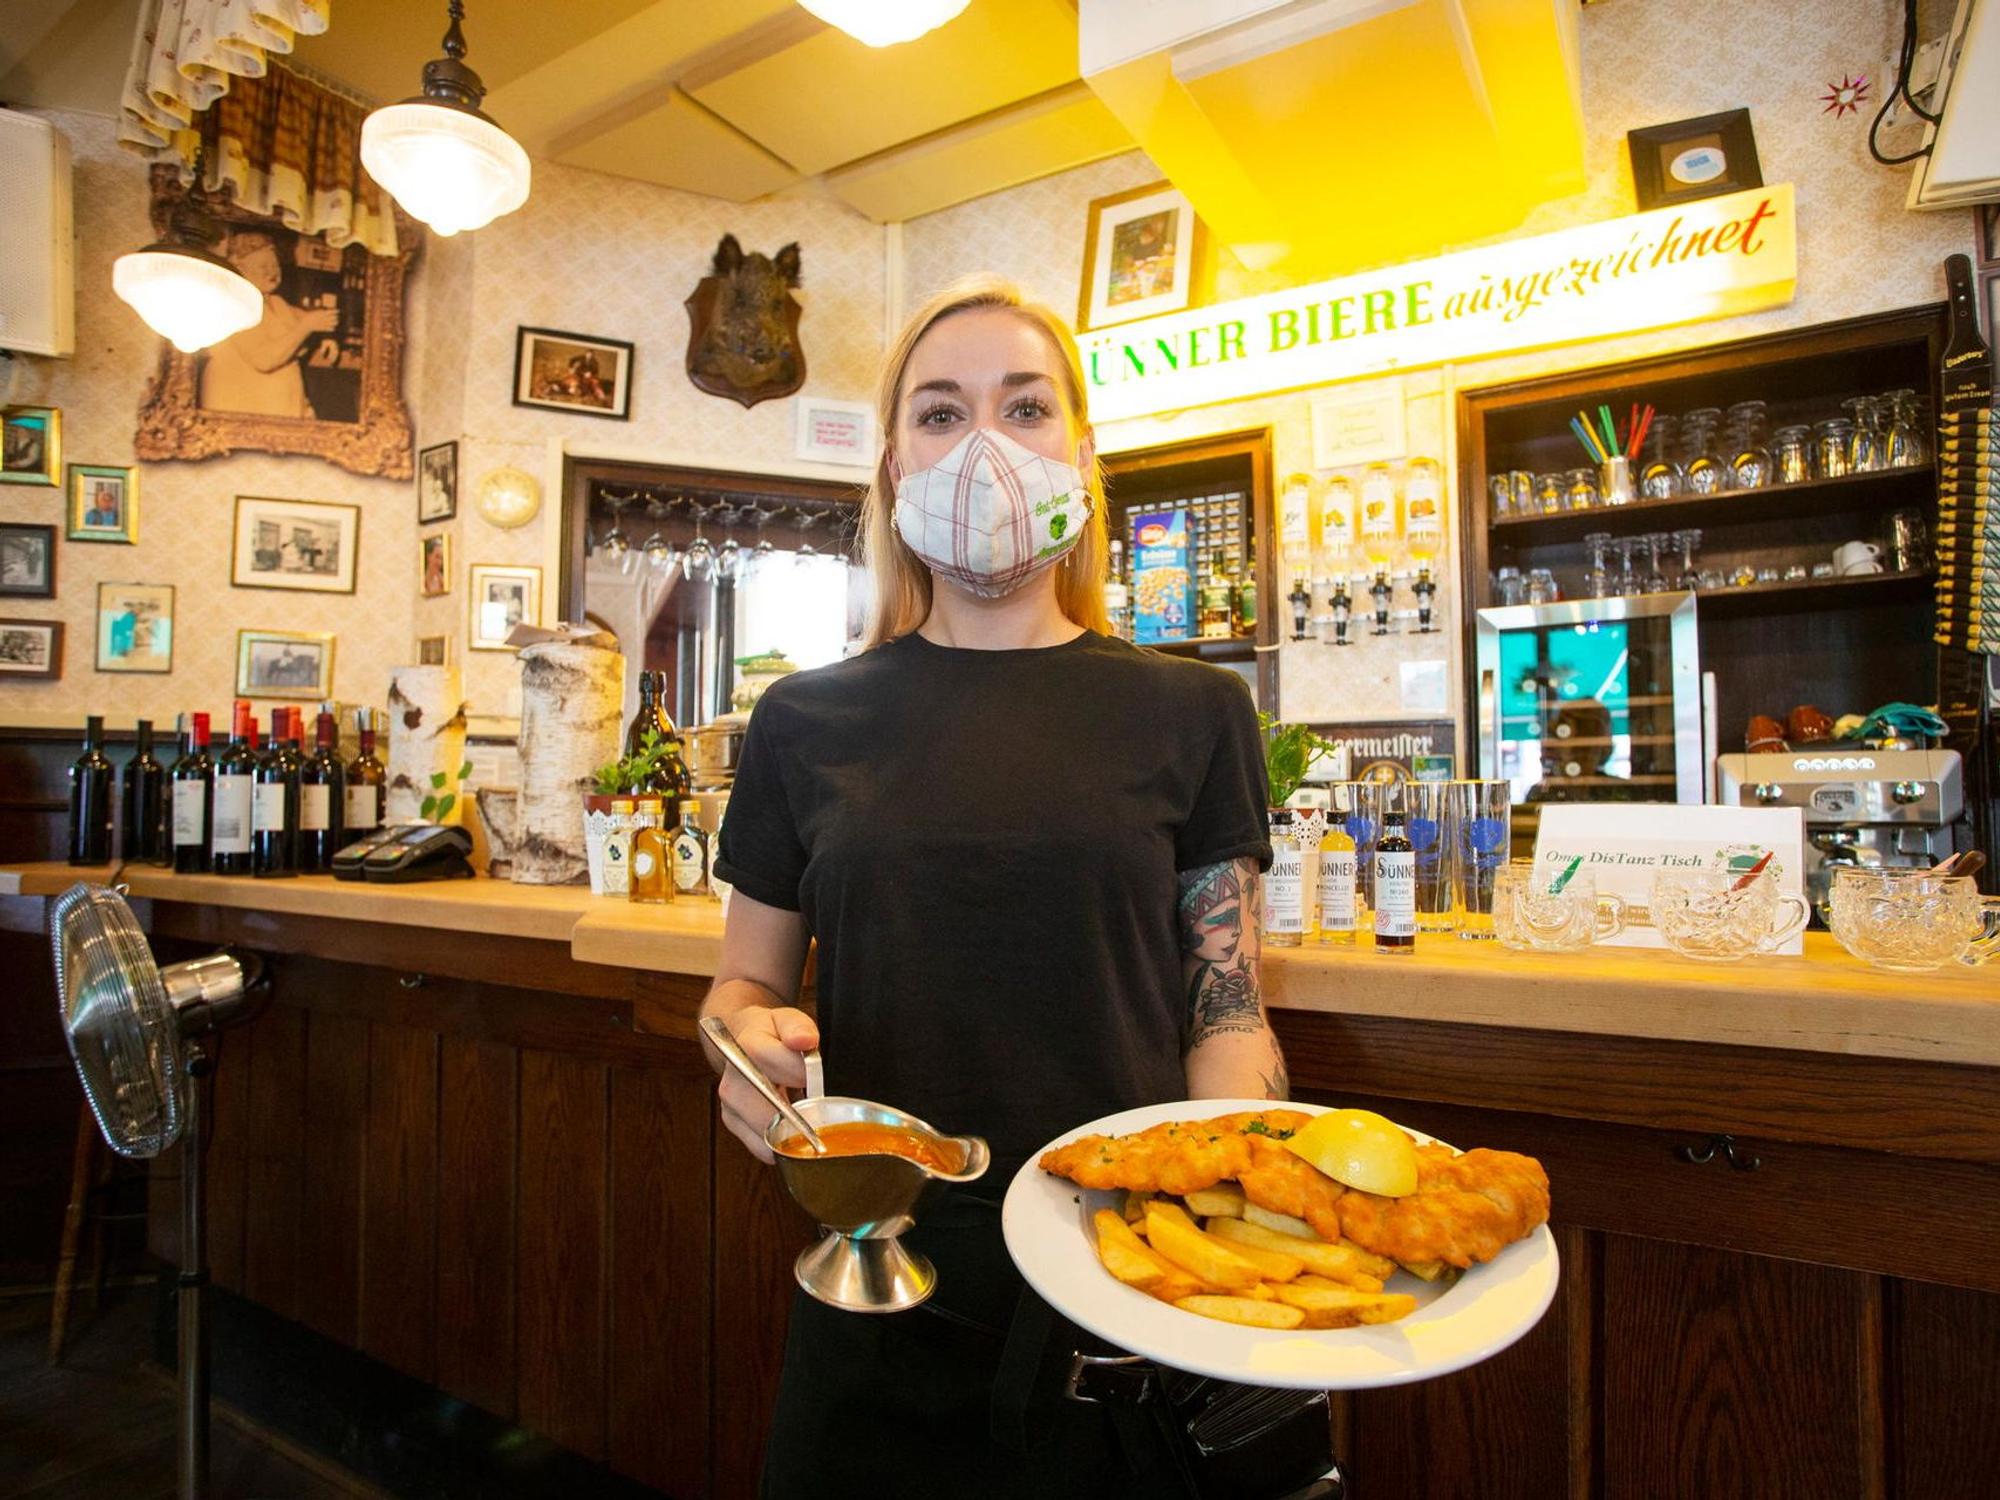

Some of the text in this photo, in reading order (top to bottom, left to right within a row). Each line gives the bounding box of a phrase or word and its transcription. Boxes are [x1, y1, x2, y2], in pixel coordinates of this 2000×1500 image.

[1090, 320, 1247, 386] ÜNNER
[1267, 279, 1434, 352] BIERE
[1590, 851, 1655, 866] DisTanz
[1660, 853, 1703, 867] Tisch
